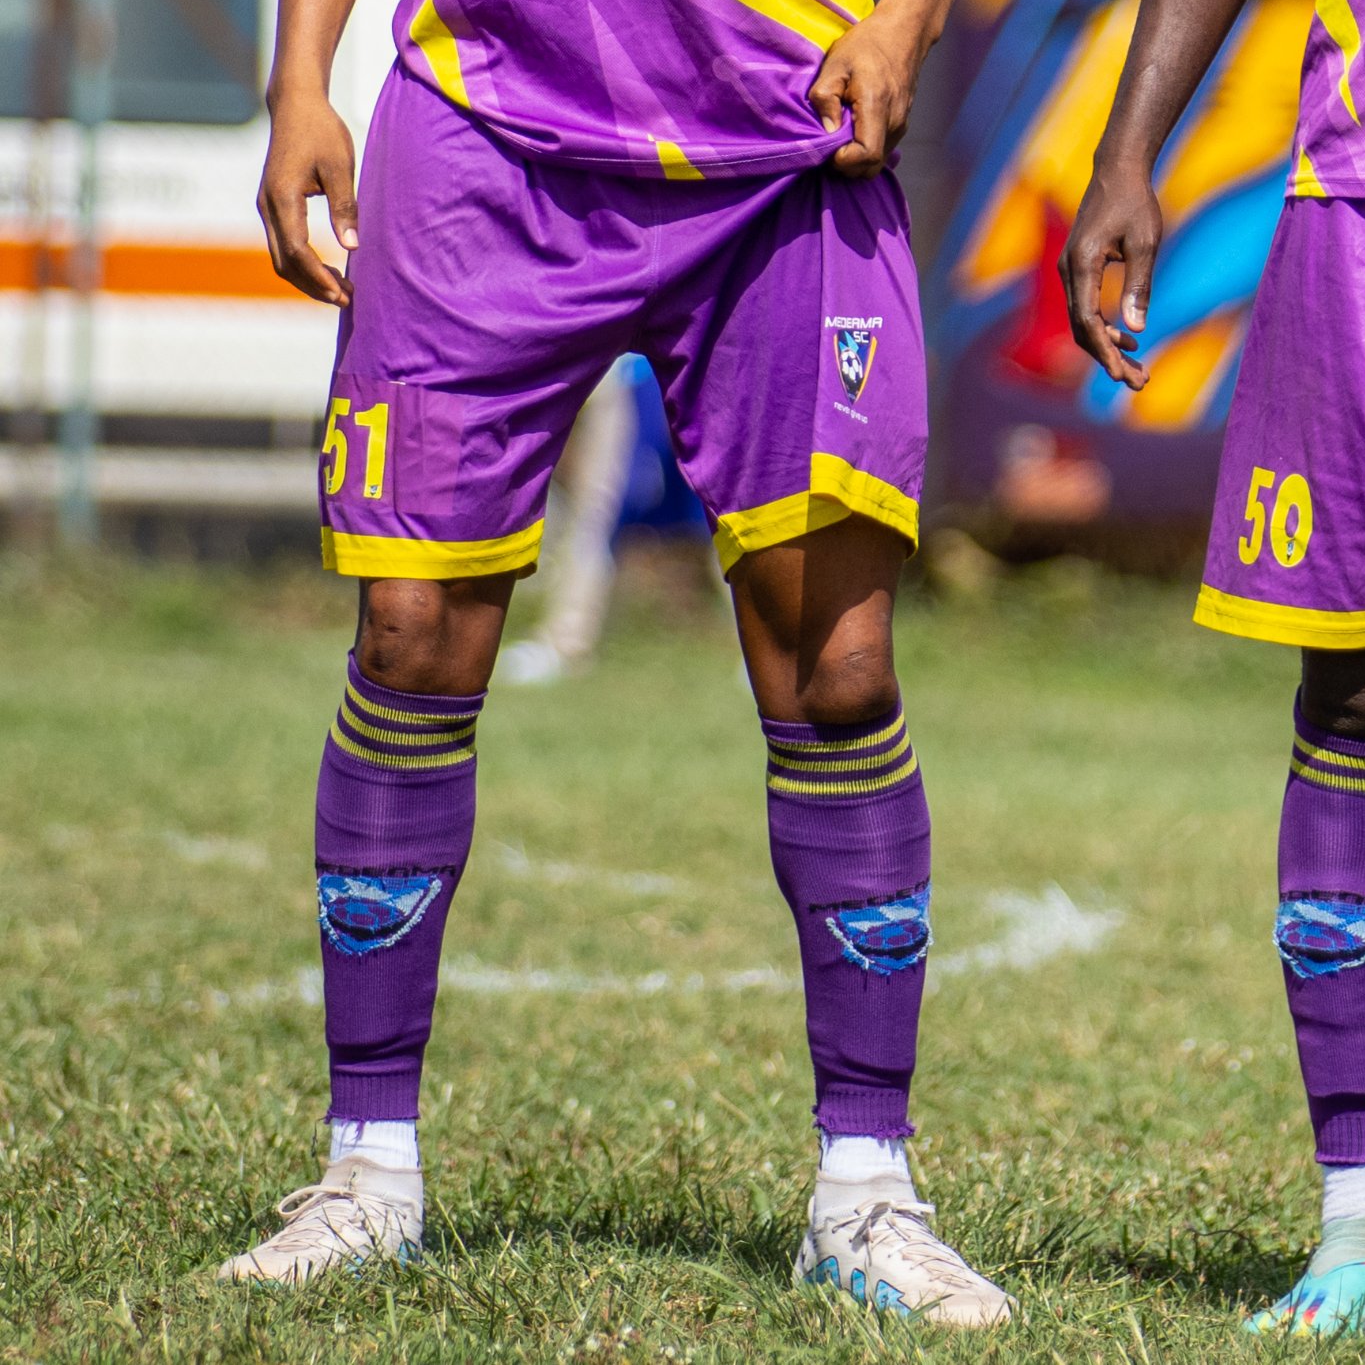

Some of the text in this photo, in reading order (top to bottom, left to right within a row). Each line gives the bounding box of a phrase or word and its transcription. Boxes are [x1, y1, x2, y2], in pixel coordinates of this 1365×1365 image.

[853, 331, 869, 344] SC
[322, 397, 389, 500] 51
[1238, 466, 1314, 568] 50
